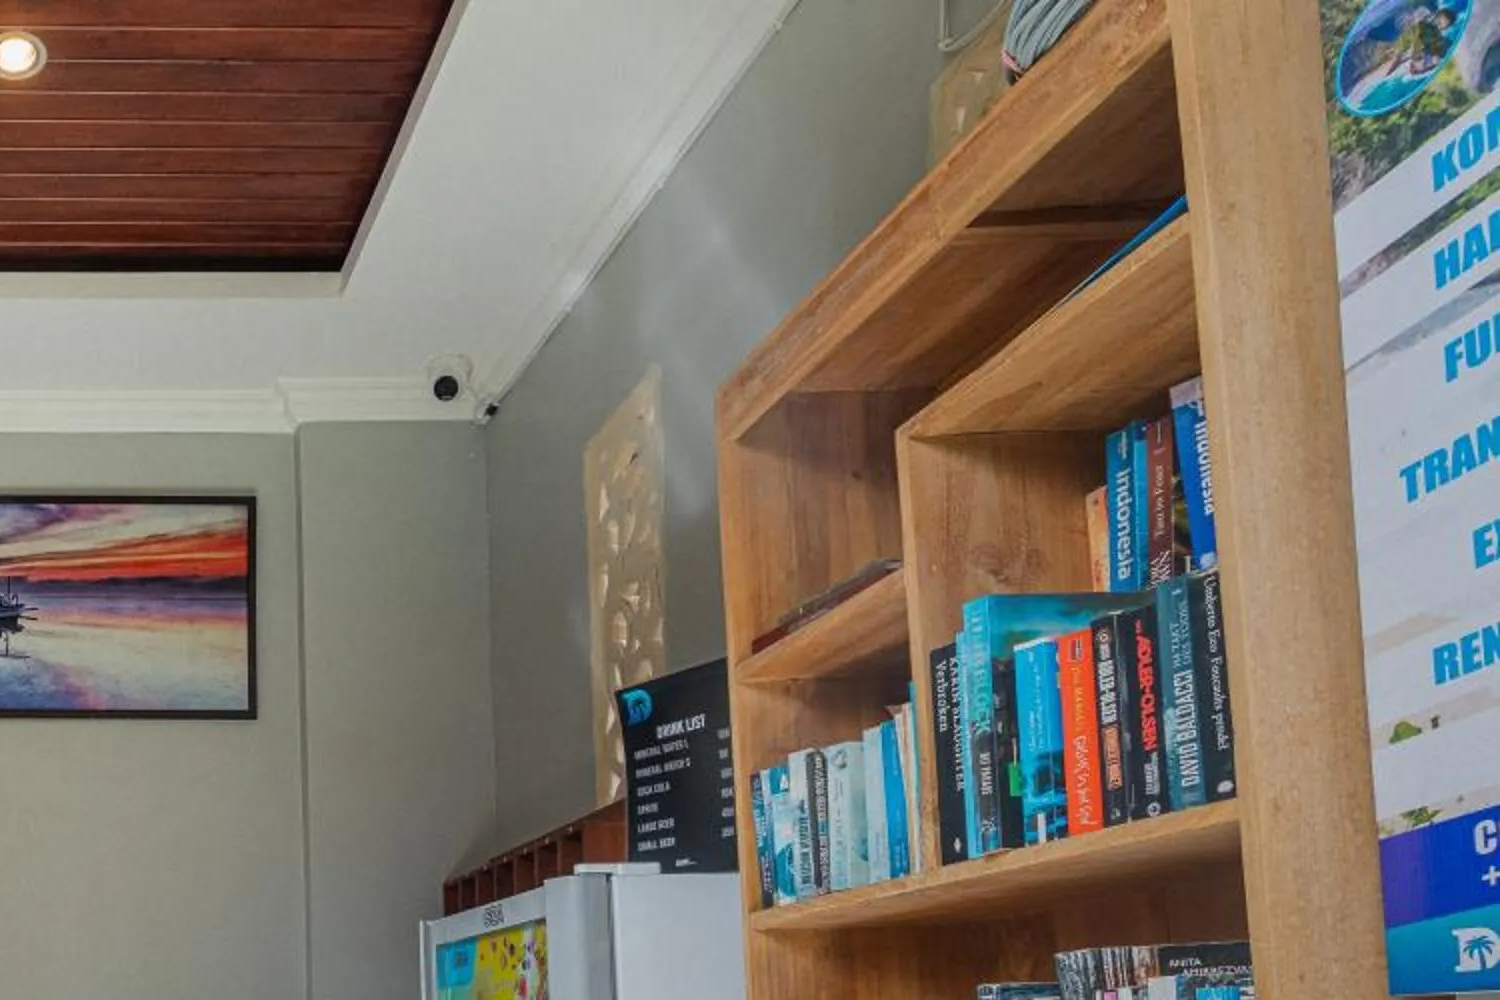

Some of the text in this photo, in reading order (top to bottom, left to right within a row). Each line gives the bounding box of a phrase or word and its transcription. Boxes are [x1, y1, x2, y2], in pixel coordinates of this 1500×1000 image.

[1444, 312, 1500, 383] FU
[1115, 467, 1133, 580] Indonesia
[1472, 517, 1500, 569] E
[685, 713, 706, 731] LIST
[935, 658, 949, 733] Verbroken
[1136, 636, 1158, 752] ADLER-OLSEN
[1173, 669, 1200, 788] DAVID BALDACCI
